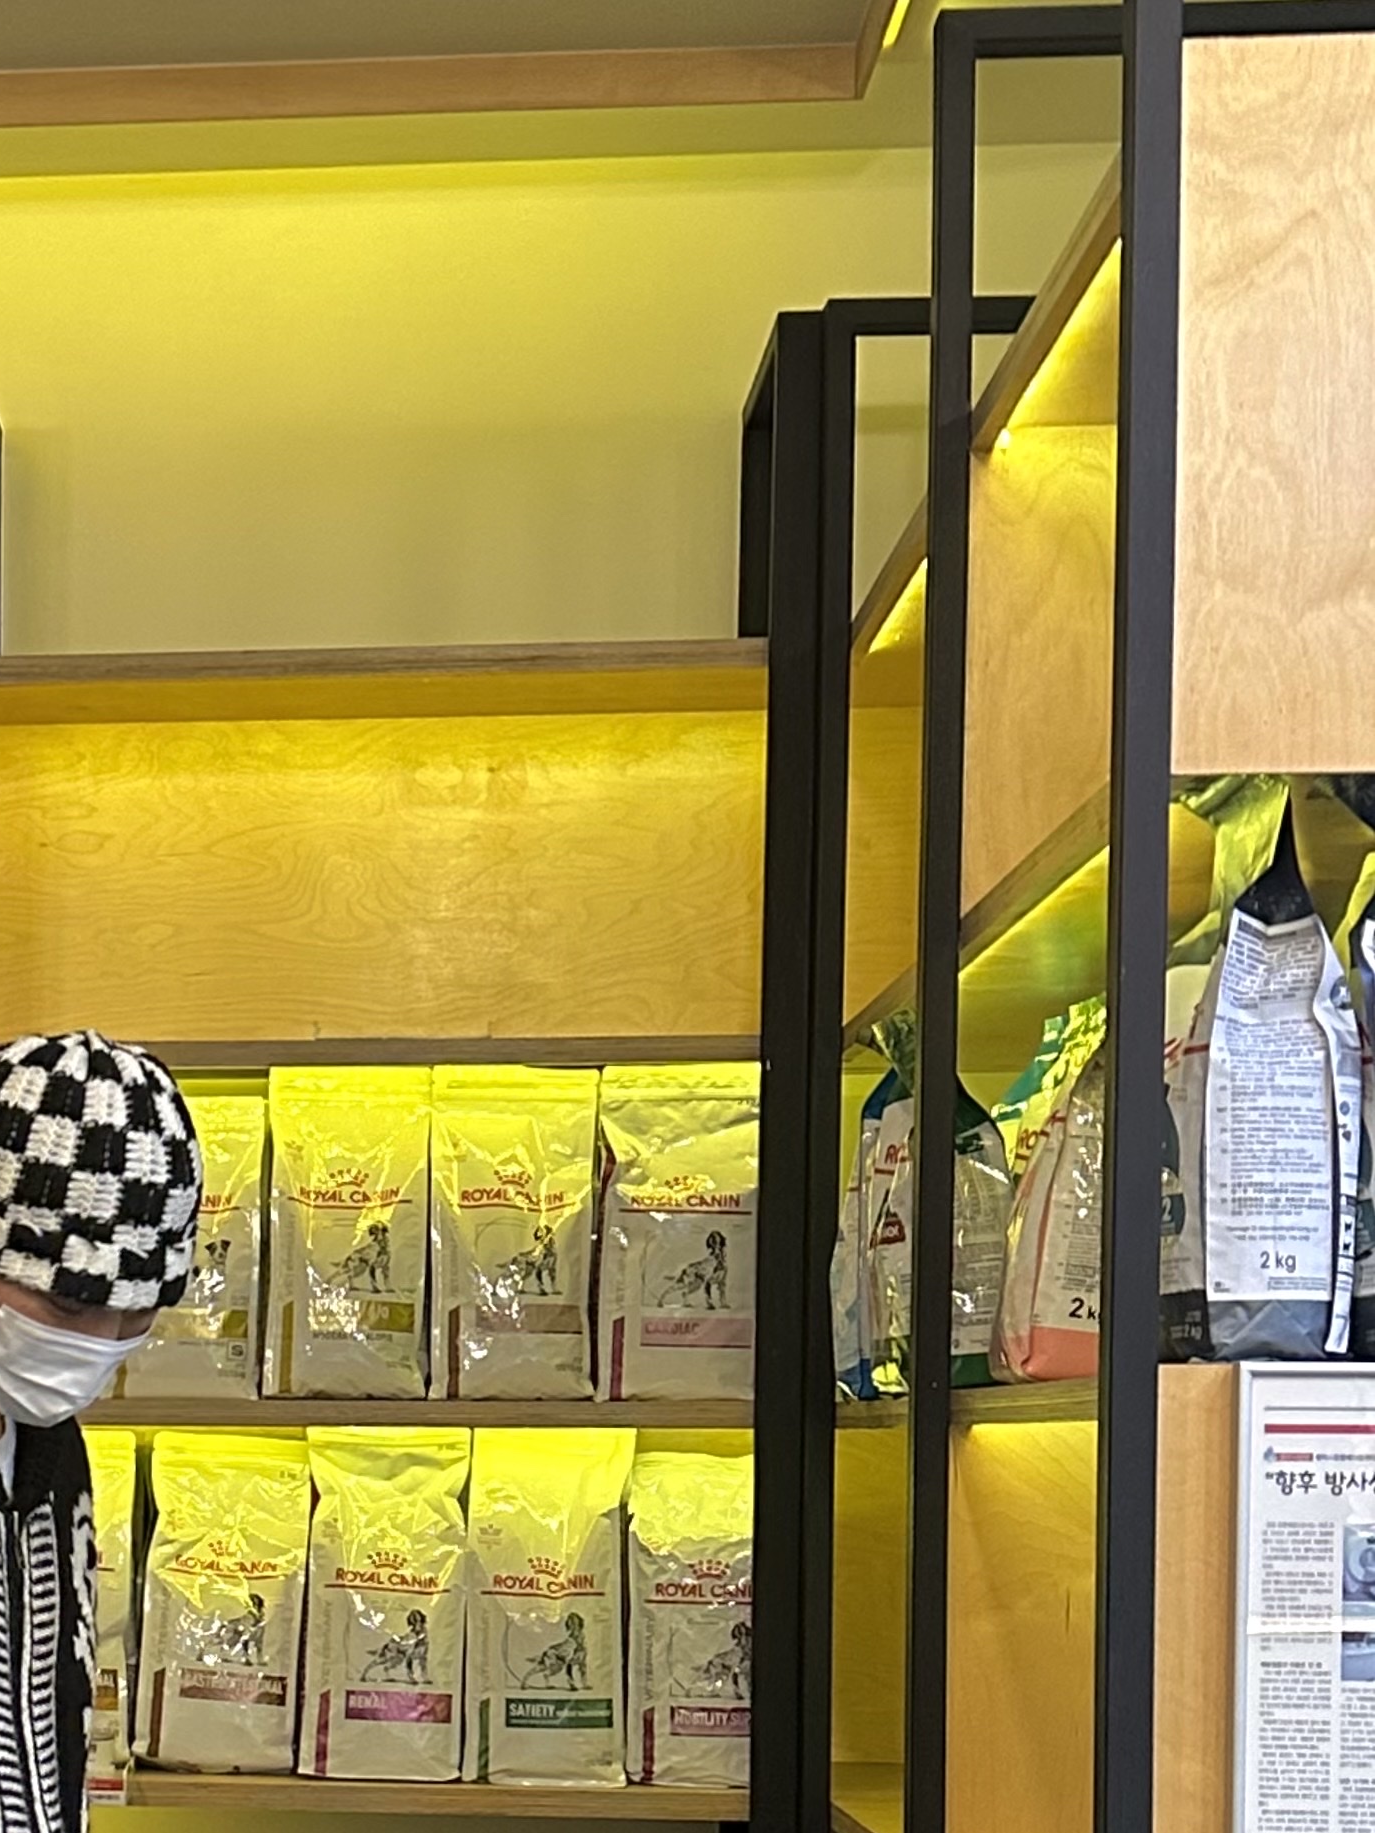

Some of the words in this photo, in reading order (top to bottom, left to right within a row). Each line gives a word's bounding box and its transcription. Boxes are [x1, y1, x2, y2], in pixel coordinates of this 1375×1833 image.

[300, 1186, 346, 1203] ROYAL
[461, 1188, 509, 1203] ROYAL
[686, 1194, 741, 1208] CANIN
[1260, 1251, 1270, 1269] 2
[1275, 1251, 1297, 1273] kg
[1069, 1297, 1085, 1319] 2
[335, 1568, 384, 1585] ROYAL
[387, 1573, 440, 1589] CANIN
[493, 1574, 543, 1591] ROYAL
[546, 1574, 595, 1593] CANIN
[655, 1583, 706, 1598] ROYAL
[710, 1584, 752, 1598] CANI
[509, 1703, 555, 1717] SATIETY
